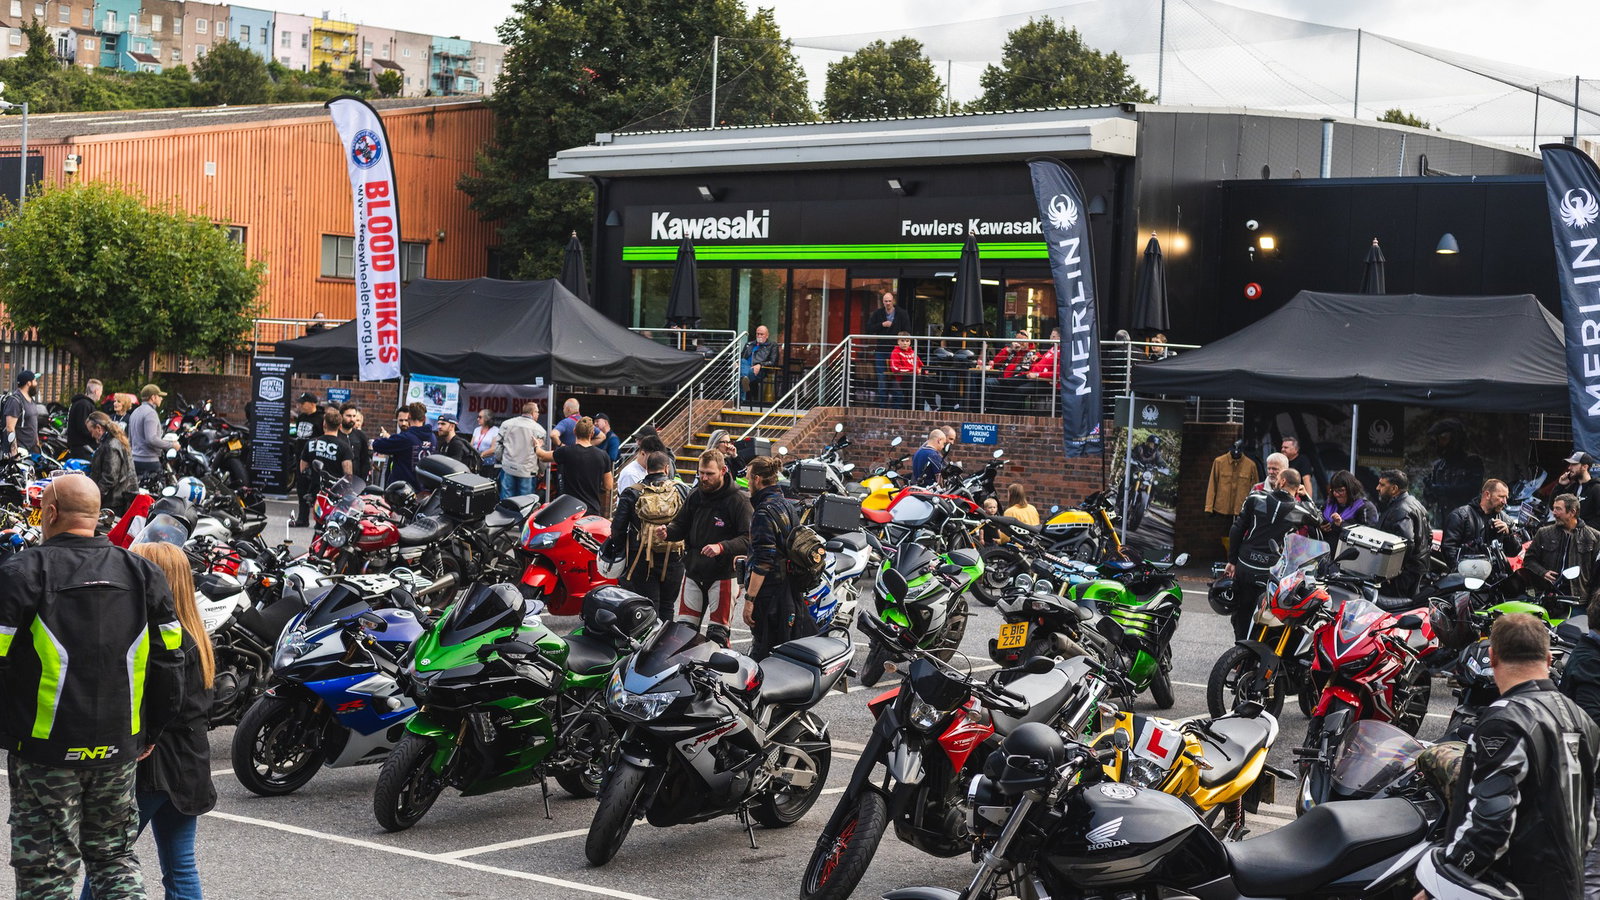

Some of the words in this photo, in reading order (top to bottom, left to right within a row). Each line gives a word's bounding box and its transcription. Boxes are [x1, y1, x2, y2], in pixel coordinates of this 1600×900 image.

[365, 181, 395, 271] BLOOD
[651, 209, 769, 240] Kawasaki
[901, 219, 963, 236] Fowlers
[968, 217, 1044, 236] Kawasak
[374, 282, 398, 364] BIKES
[1059, 237, 1092, 396] MERLIN
[468, 396, 508, 414] BLOOD
[511, 397, 548, 415] BIS
[963, 424, 996, 432] MOTORCYCLE
[968, 430, 990, 438] PARKING
[308, 440, 338, 456] EBC
[1002, 635, 1022, 647] ZZR
[1146, 726, 1169, 760] L
[1087, 838, 1131, 851] HONDA
